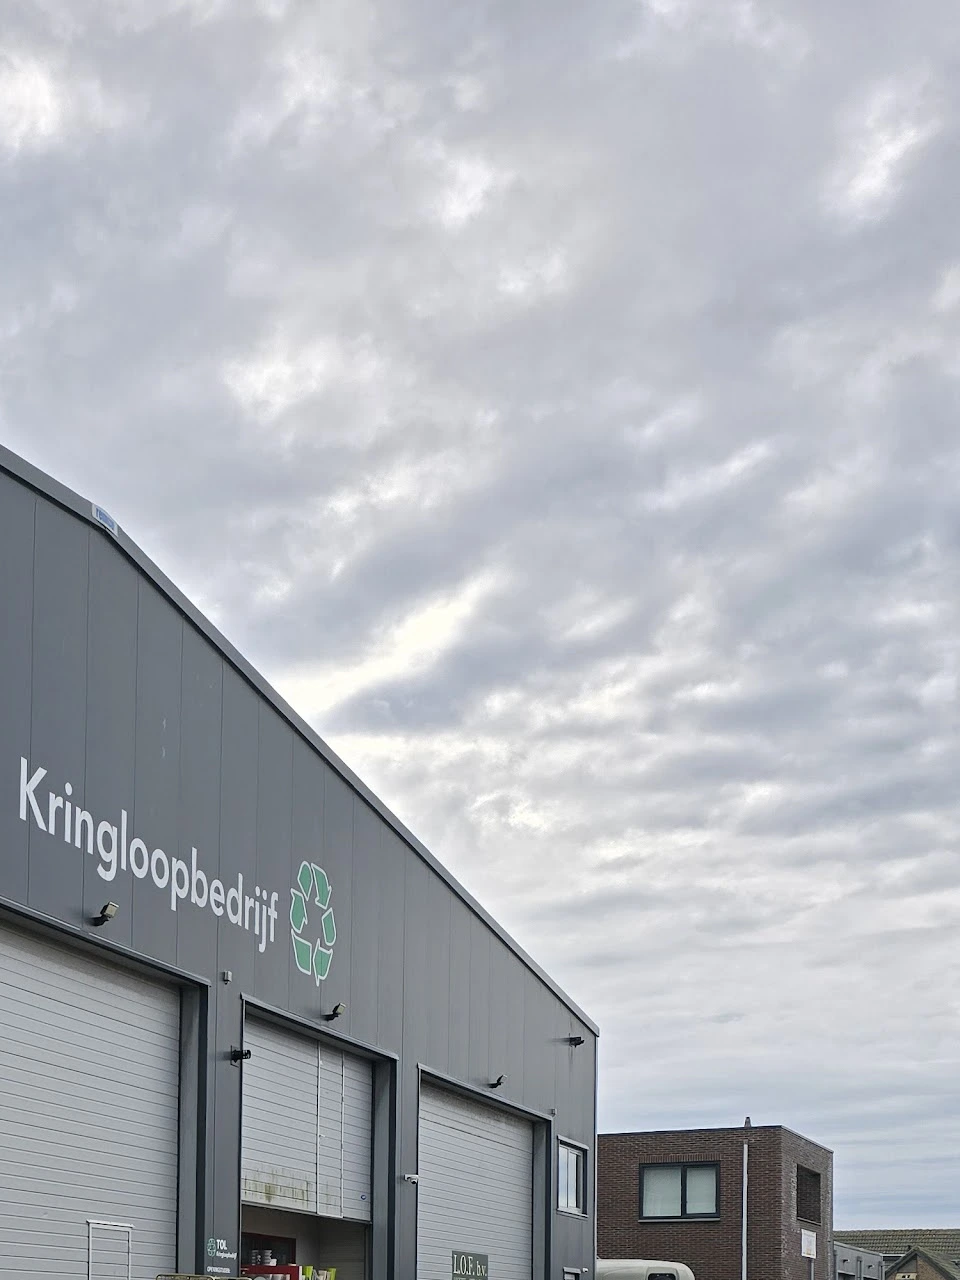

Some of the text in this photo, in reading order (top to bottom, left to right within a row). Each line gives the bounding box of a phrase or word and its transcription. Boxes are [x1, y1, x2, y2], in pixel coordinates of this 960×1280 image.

[19, 756, 279, 953] Kringloopbedrijf
[216, 1239, 228, 1250] TOL
[453, 1254, 488, 1277] L.O.F. b.v.
